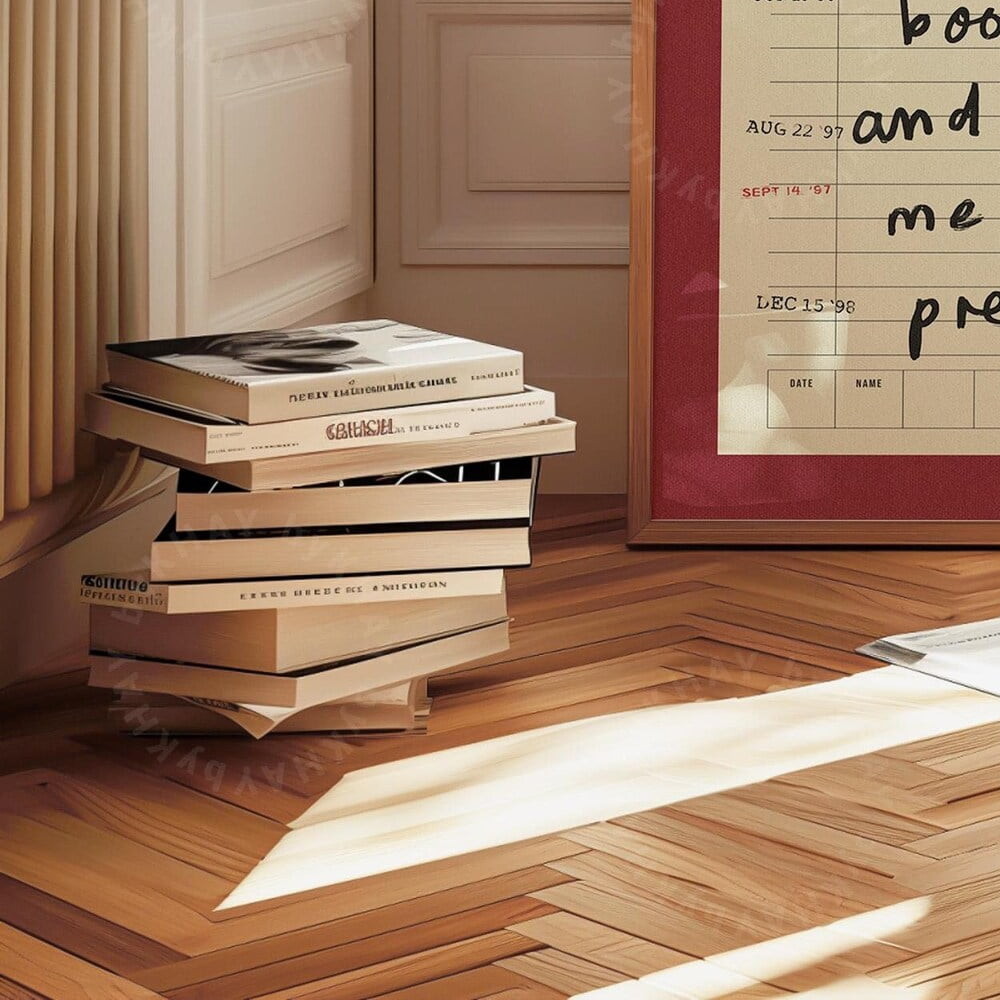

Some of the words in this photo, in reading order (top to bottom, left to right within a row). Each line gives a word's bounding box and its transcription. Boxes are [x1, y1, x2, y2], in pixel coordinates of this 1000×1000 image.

[852, 81, 980, 144] and
[745, 119, 787, 136] AUG
[791, 123, 813, 138] 22
[742, 186, 780, 198] SEPT
[786, 186, 801, 196] 14
[887, 198, 985, 236] me
[802, 298, 824, 313] 15
[789, 378, 813, 389] DATE
[855, 378, 882, 389] NAME
